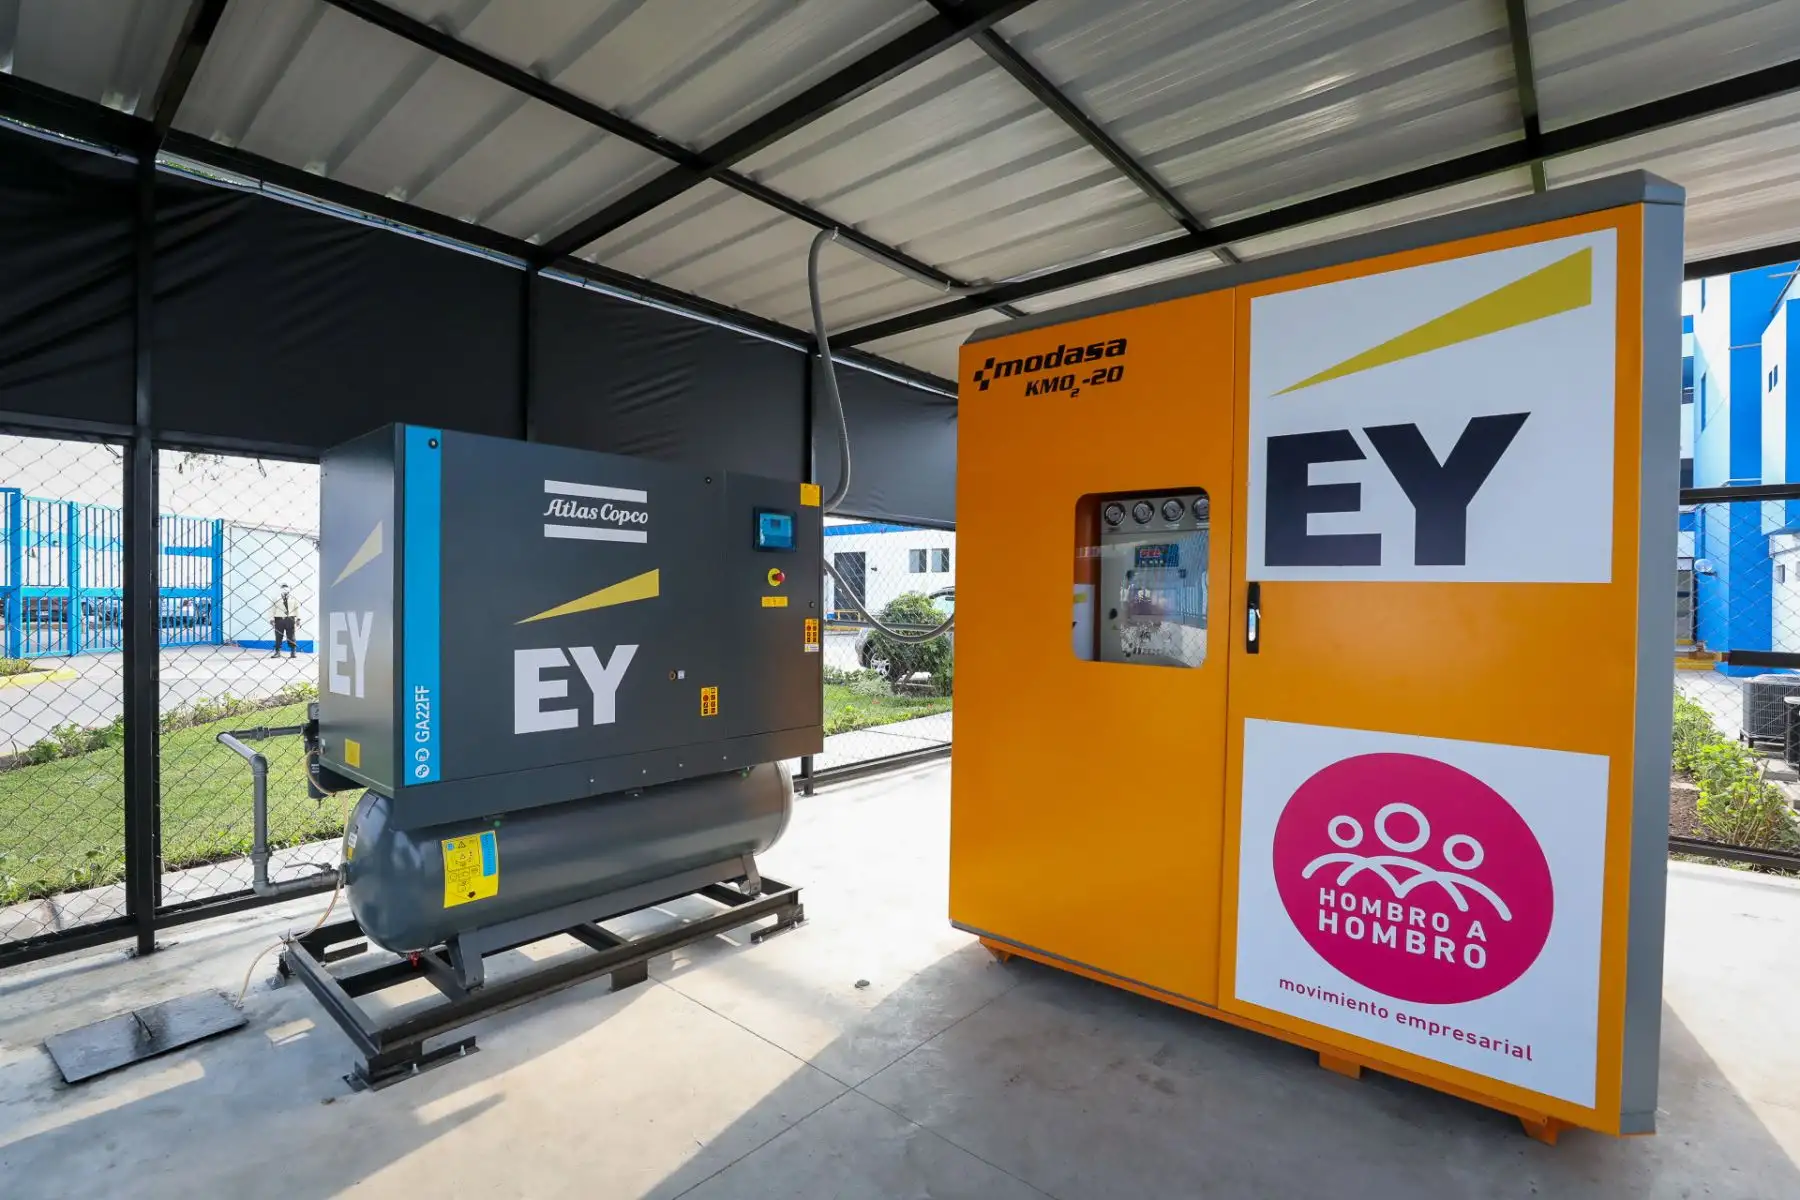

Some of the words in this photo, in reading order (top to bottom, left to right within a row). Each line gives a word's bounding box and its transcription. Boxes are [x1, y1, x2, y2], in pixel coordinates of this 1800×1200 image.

[993, 338, 1127, 379] modasa
[543, 499, 599, 520] Atlas
[600, 503, 649, 525] Copco
[1264, 411, 1531, 566] EY
[328, 611, 374, 698] EY
[414, 685, 431, 743] GA22FF
[514, 644, 640, 734] EY
[1318, 887, 1450, 933] HOMBRO
[1466, 920, 1487, 942] A
[1318, 909, 1487, 969] HOMBRO
[1278, 977, 1389, 1020] movimiento
[1396, 1012, 1534, 1062] empresarial
